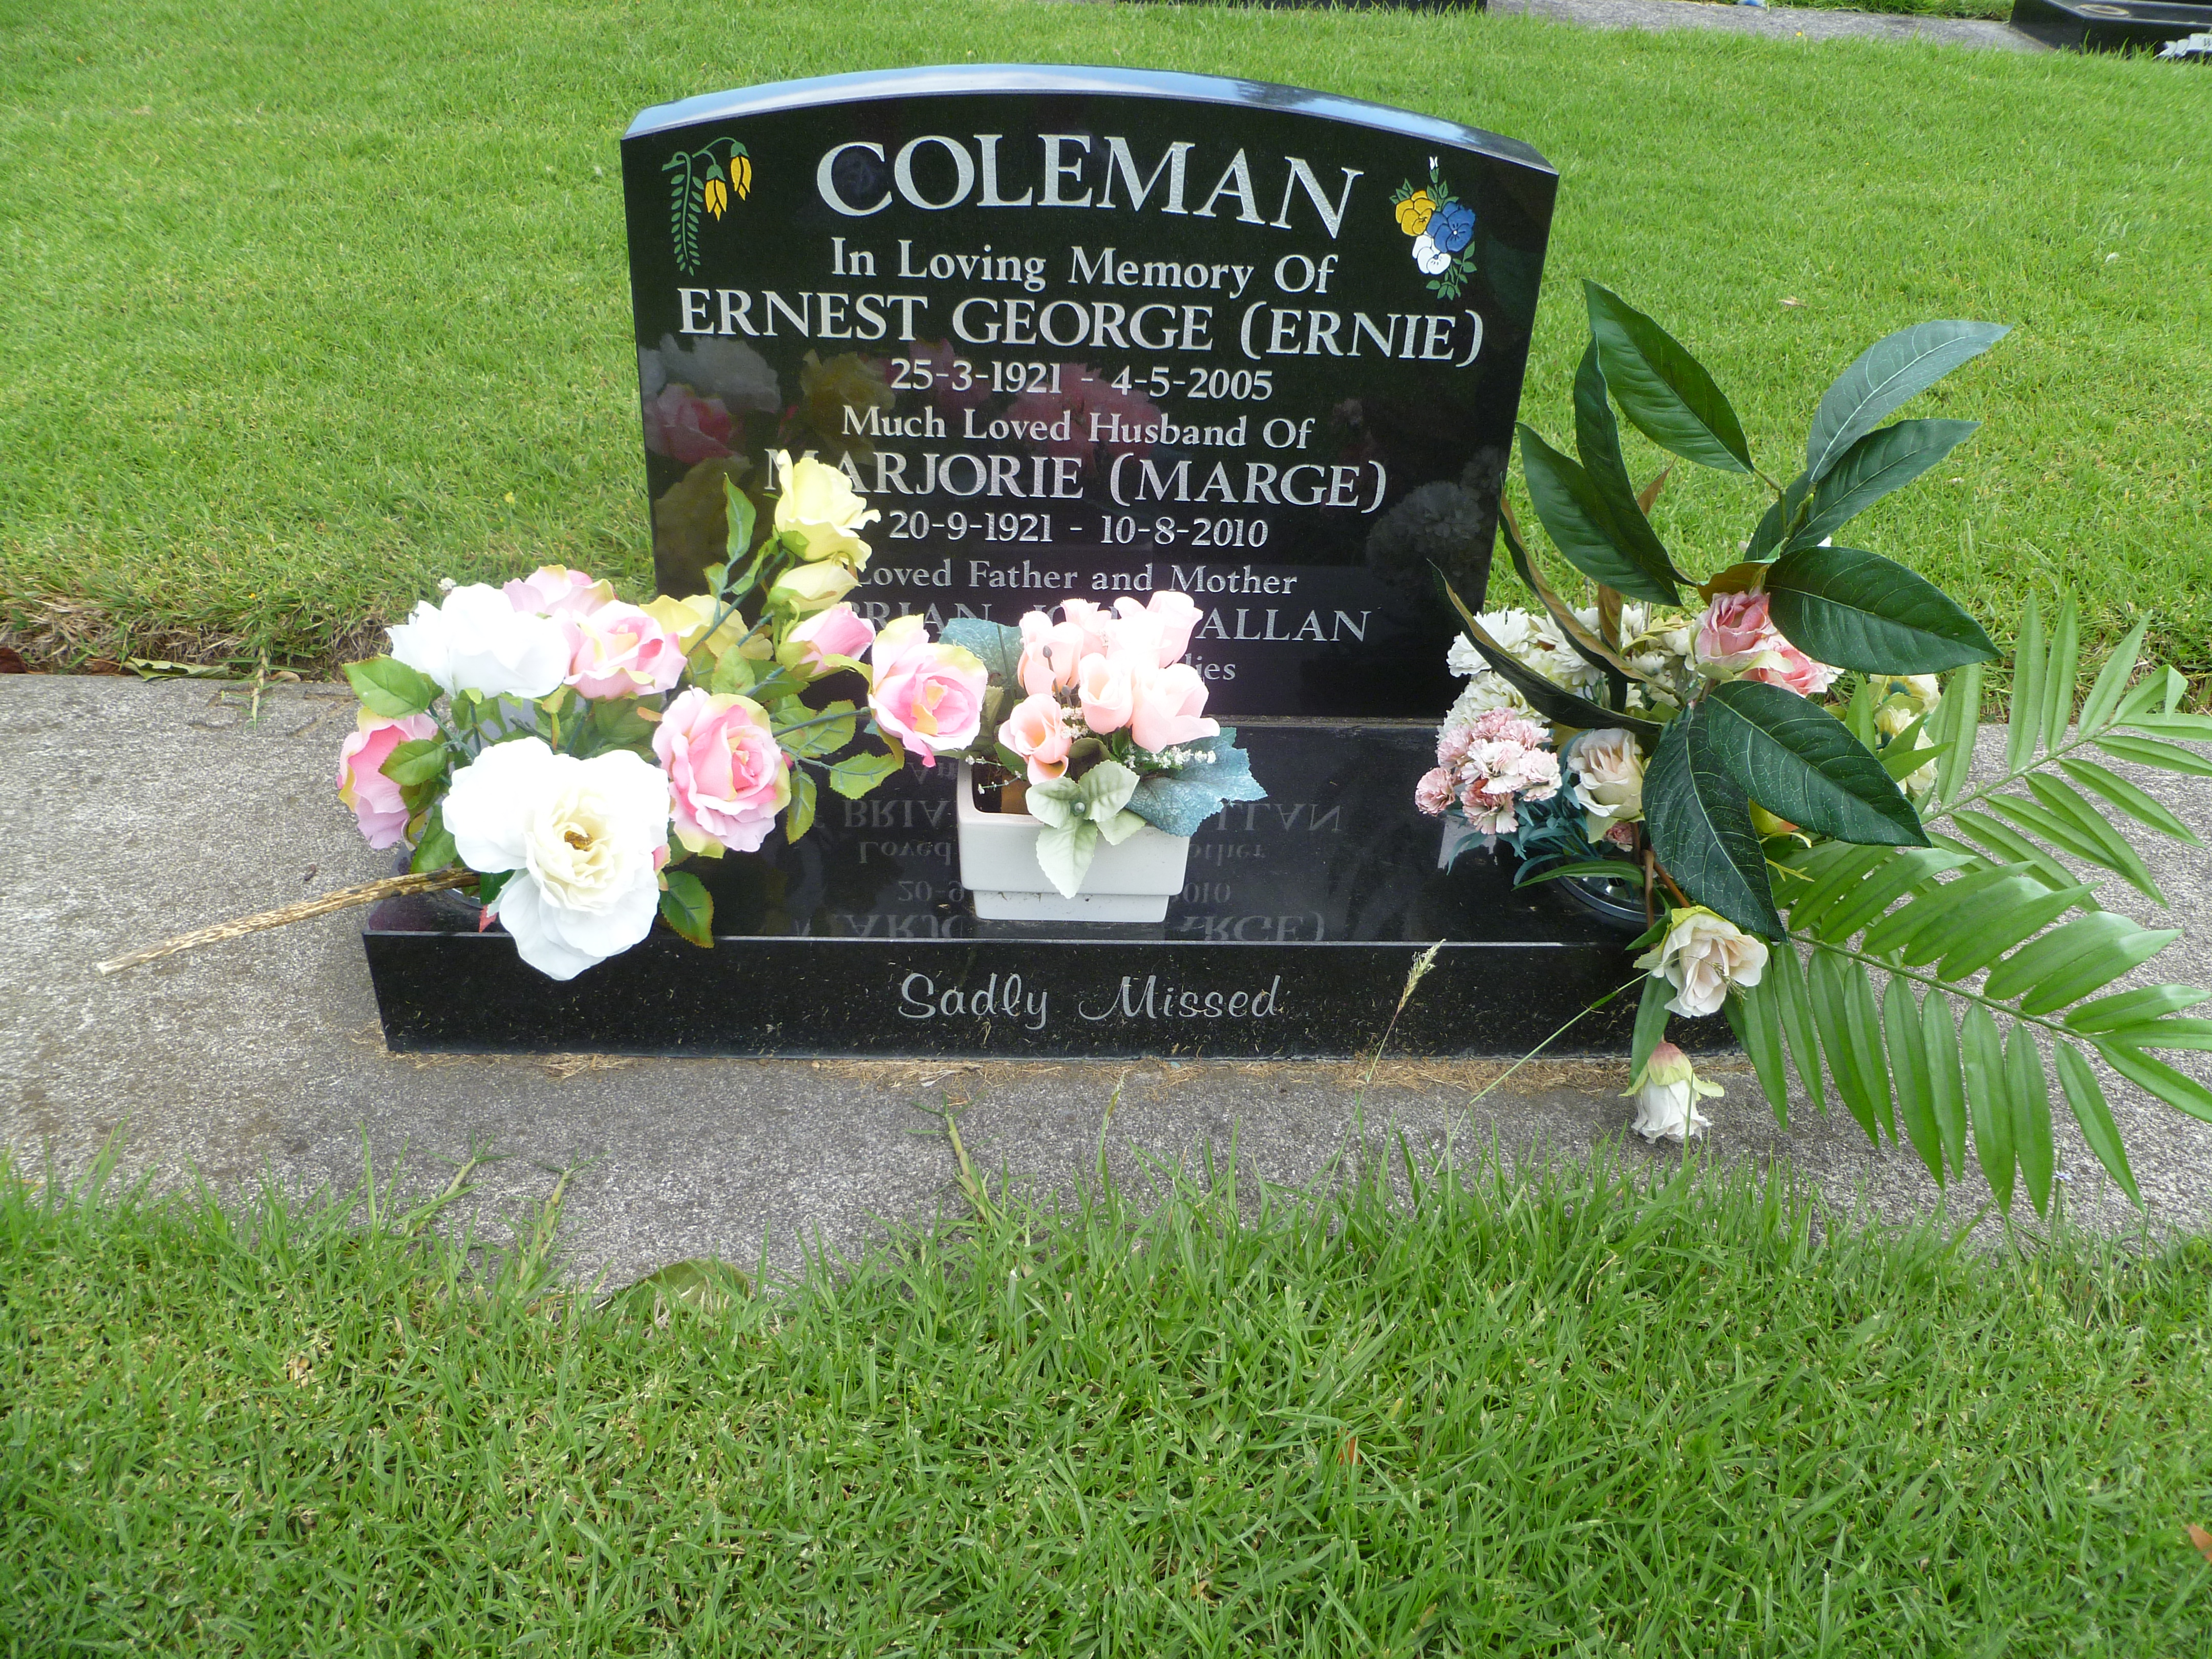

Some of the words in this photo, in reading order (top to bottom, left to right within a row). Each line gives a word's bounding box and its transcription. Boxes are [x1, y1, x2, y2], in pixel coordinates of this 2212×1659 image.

[816, 134, 1365, 239] COLEMAN
[831, 237, 877, 276] In
[898, 239, 1047, 292] Loving
[1068, 246, 1254, 299] Memory
[1274, 253, 1338, 293] Of
[677, 288, 929, 341] ERNEST
[952, 297, 1214, 351] GEORGE
[1241, 301, 1484, 367] (ERNIE)
[890, 357, 1062, 394] 25-3-1921
[1110, 365, 1273, 401] 4-5-2005
[841, 405, 947, 439] Much
[963, 408, 1072, 443] Loved
[1088, 412, 1246, 447] Husband
[1263, 417, 1316, 450] Of
[1110, 452, 1387, 514] (MARGE)
[889, 510, 1053, 542] 20-9-1921
[1100, 515, 1269, 548] 10-8-2010
[859, 558, 952, 587] oved
[968, 560, 1078, 589] Father
[1091, 562, 1154, 591] and
[1167, 565, 1298, 594] Mother
[1195, 607, 1372, 642] ALLAN
[898, 972, 1048, 1030] Sadly
[1078, 974, 1281, 1022] Missed
